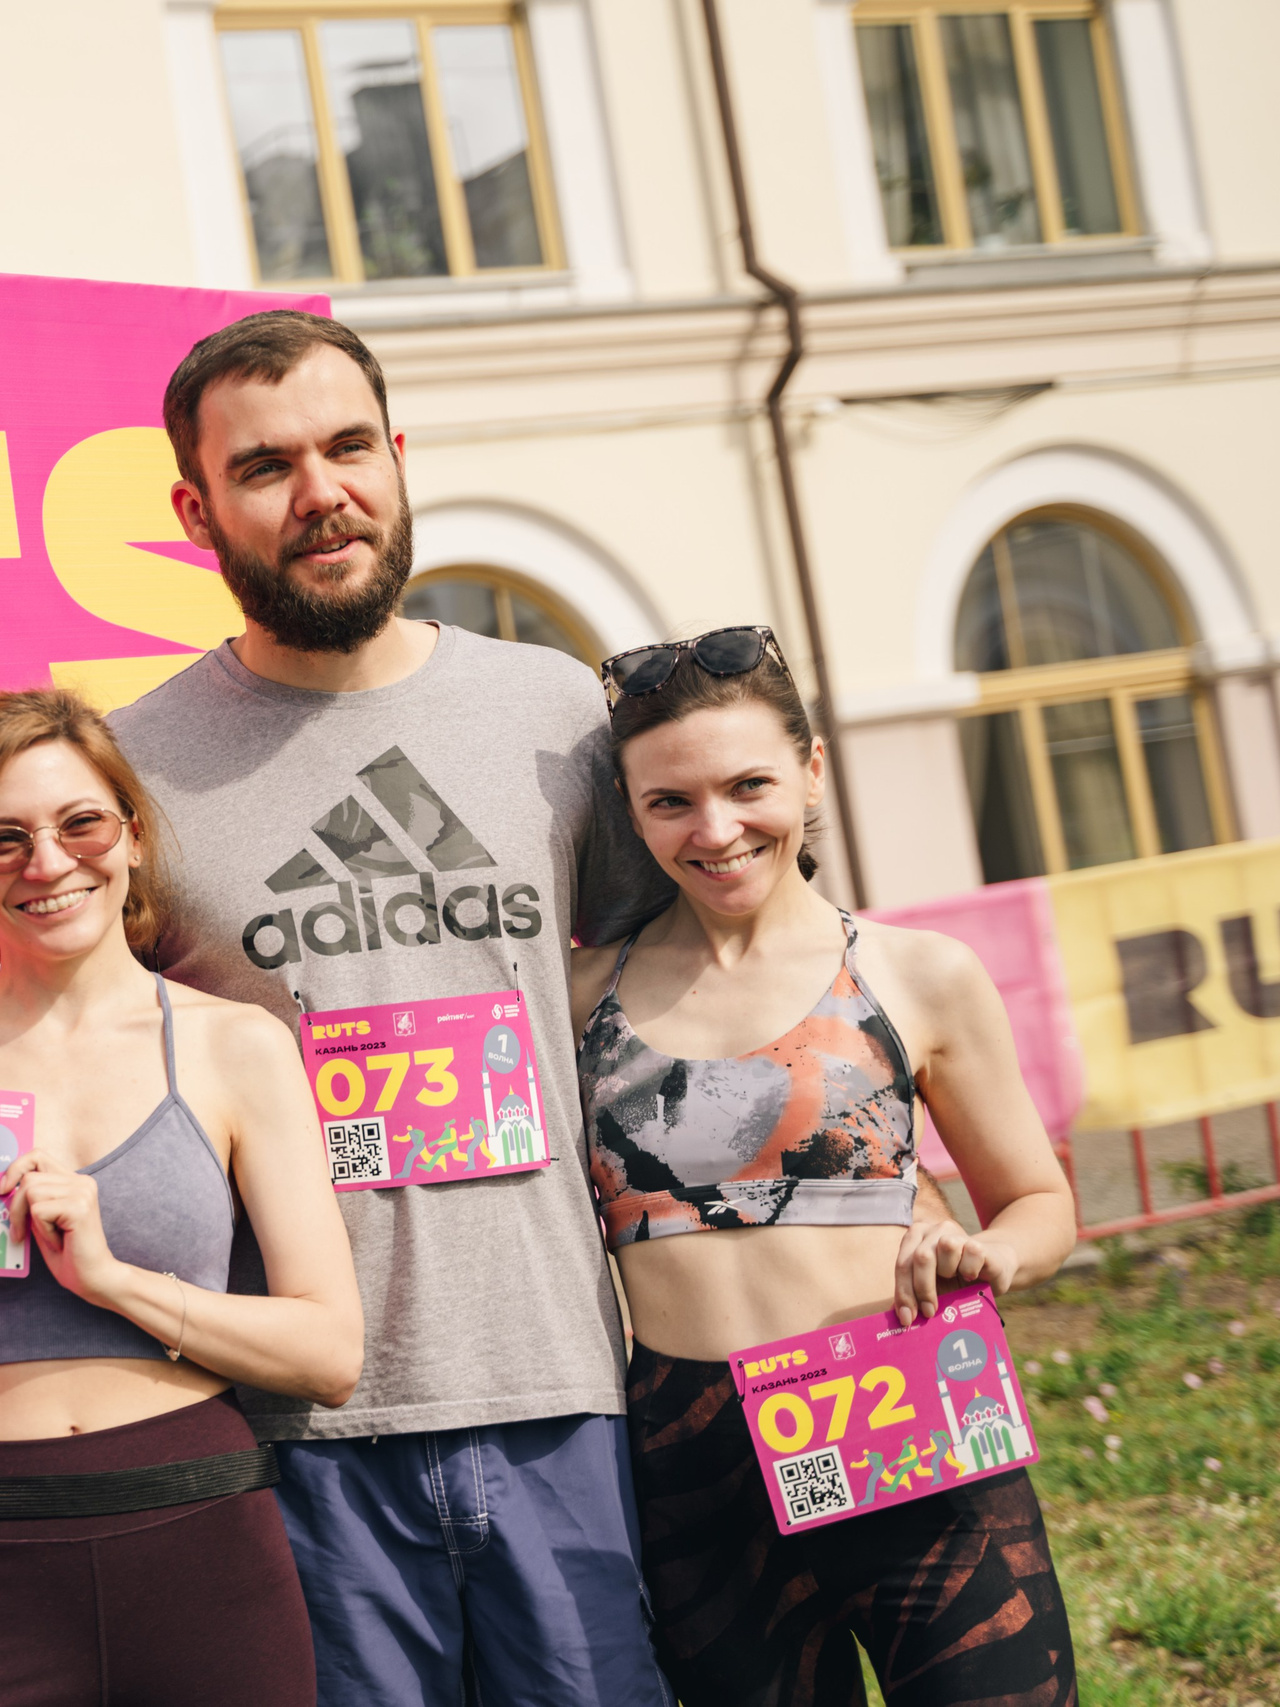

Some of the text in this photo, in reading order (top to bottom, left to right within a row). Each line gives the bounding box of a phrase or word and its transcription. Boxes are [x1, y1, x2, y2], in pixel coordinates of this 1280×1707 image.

[242, 871, 542, 970] adidas
[311, 1020, 371, 1040] RUTS
[315, 1041, 387, 1055] КАЗАНЬ 2023
[497, 1033, 508, 1054] 1
[488, 1052, 514, 1065] ВОЛНА
[315, 1047, 459, 1117] 073
[952, 1338, 968, 1360] 1
[743, 1349, 809, 1379] RUTS
[948, 1357, 983, 1373] ВОЛНА
[751, 1368, 828, 1394] КАЗАНЬ 2023
[757, 1365, 917, 1454] 072
